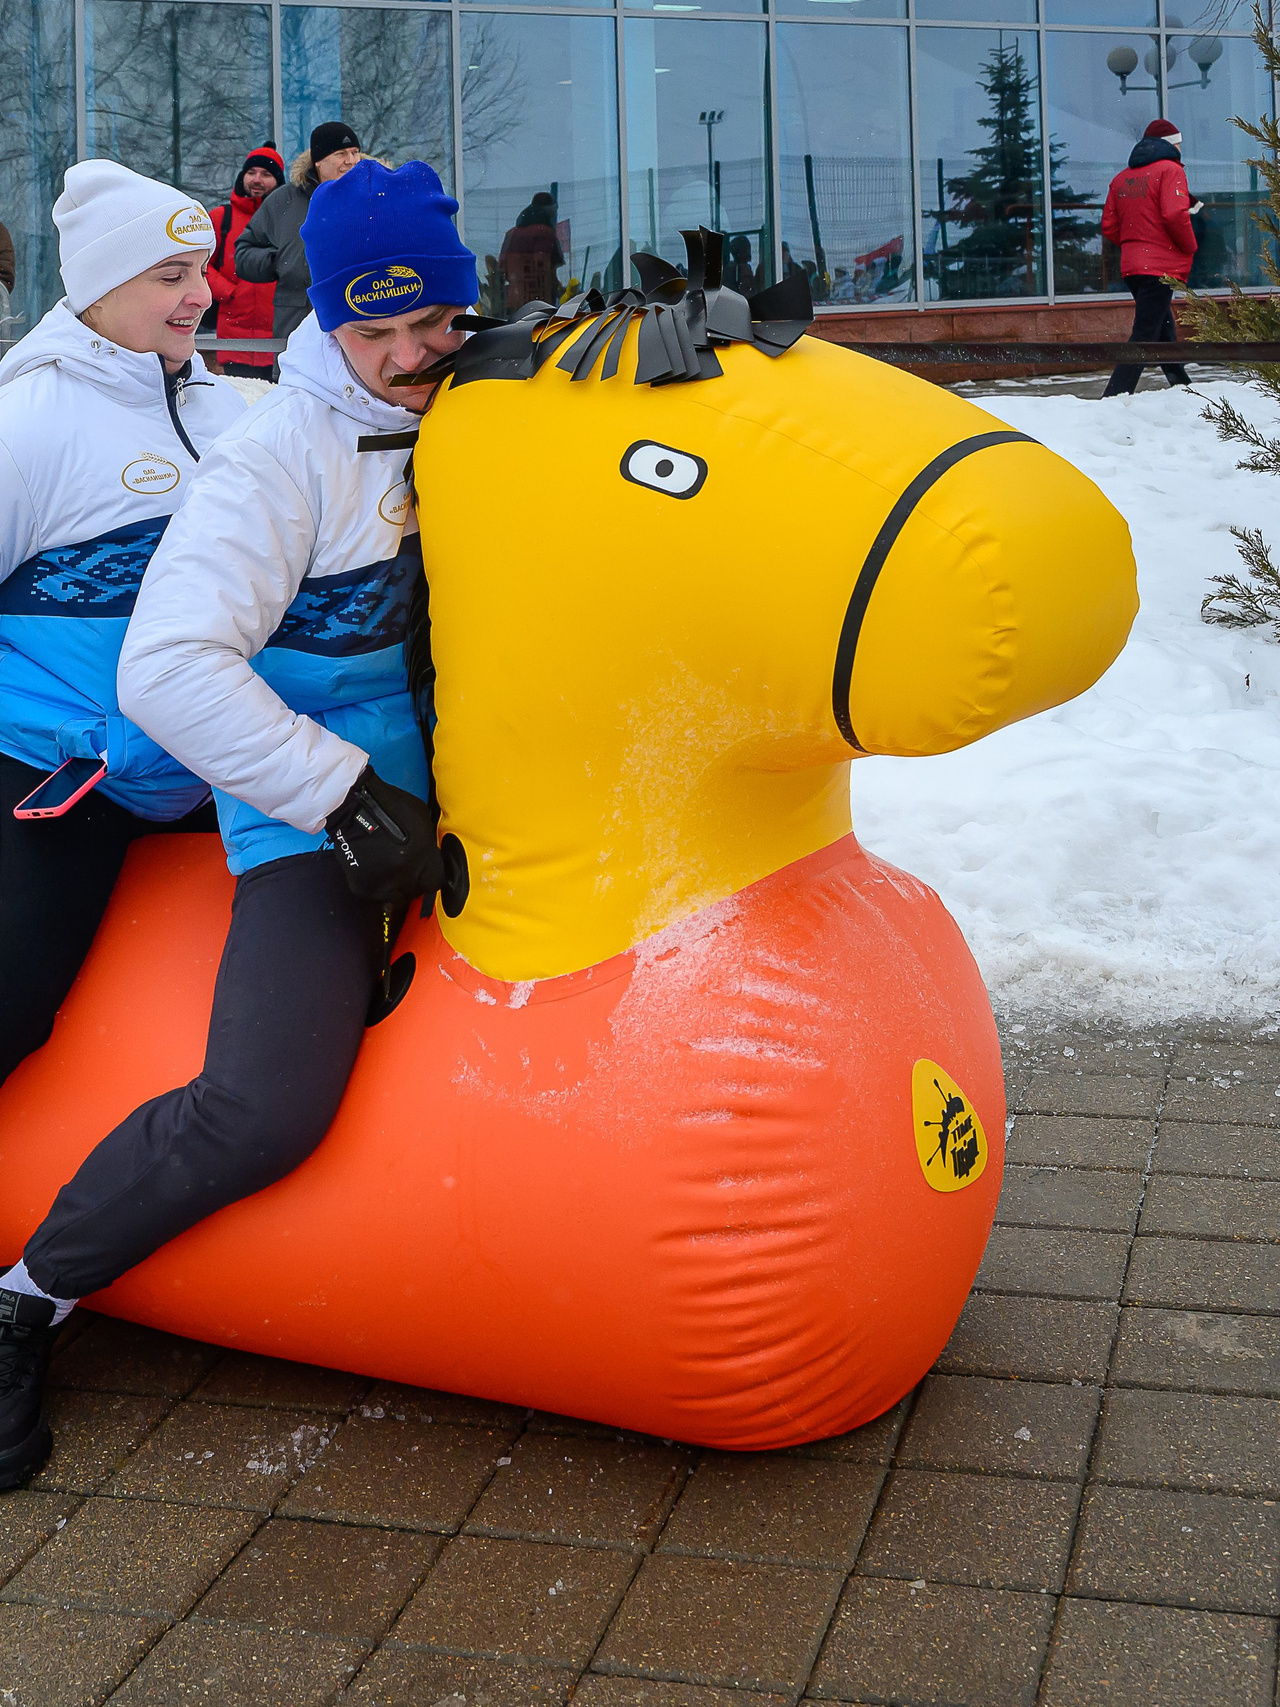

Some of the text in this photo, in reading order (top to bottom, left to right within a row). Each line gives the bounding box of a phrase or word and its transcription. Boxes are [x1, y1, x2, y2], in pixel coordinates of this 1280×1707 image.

[372, 278, 394, 290] ОАО
[352, 282, 421, 304] «ВАСИЛИШКИ»
[336, 829, 359, 867] SPORT
[2, 1293, 15, 1302] FILA
